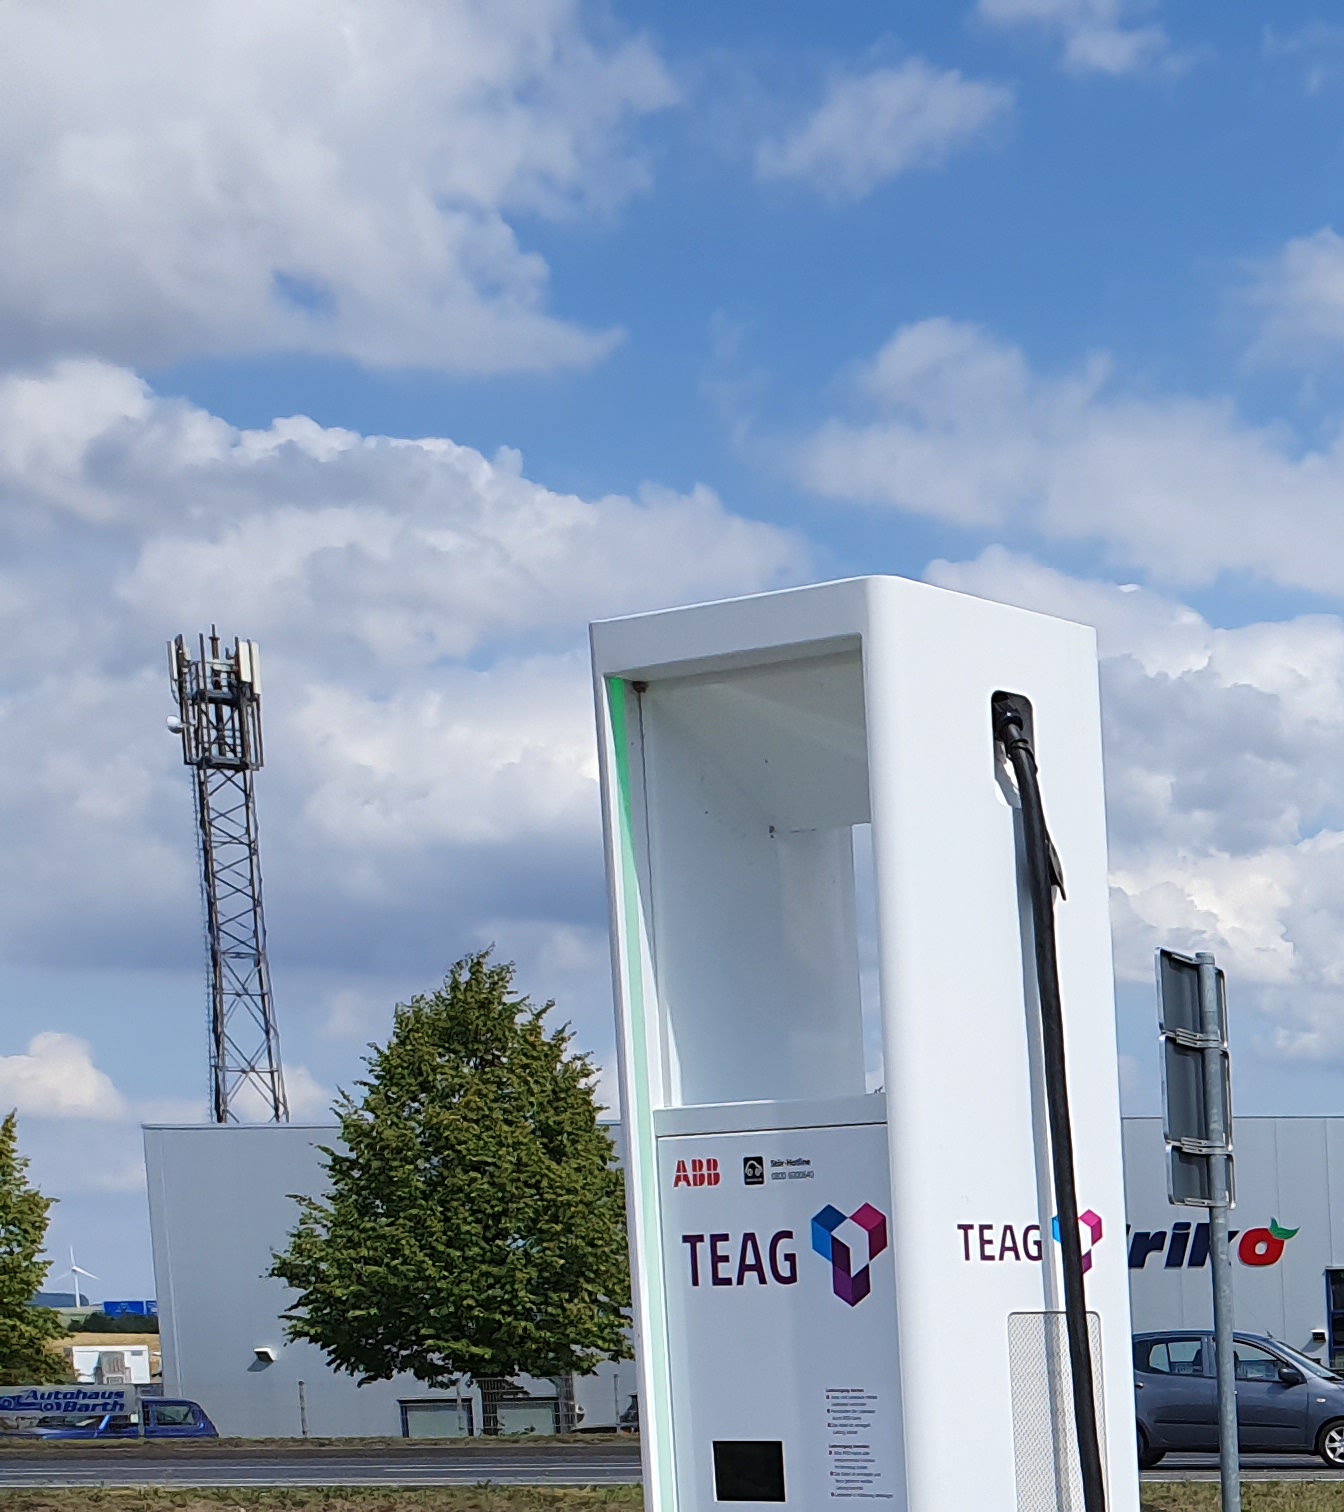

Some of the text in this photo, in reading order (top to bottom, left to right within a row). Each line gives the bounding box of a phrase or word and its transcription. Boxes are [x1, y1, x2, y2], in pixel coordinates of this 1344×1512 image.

[673, 1158, 721, 1187] ABB
[681, 1230, 798, 1287] TEAG
[957, 1223, 1044, 1263] TEAG
[1126, 1222, 1285, 1269] riko
[26, 1389, 125, 1401] Autohaus
[62, 1400, 125, 1413] Barth
